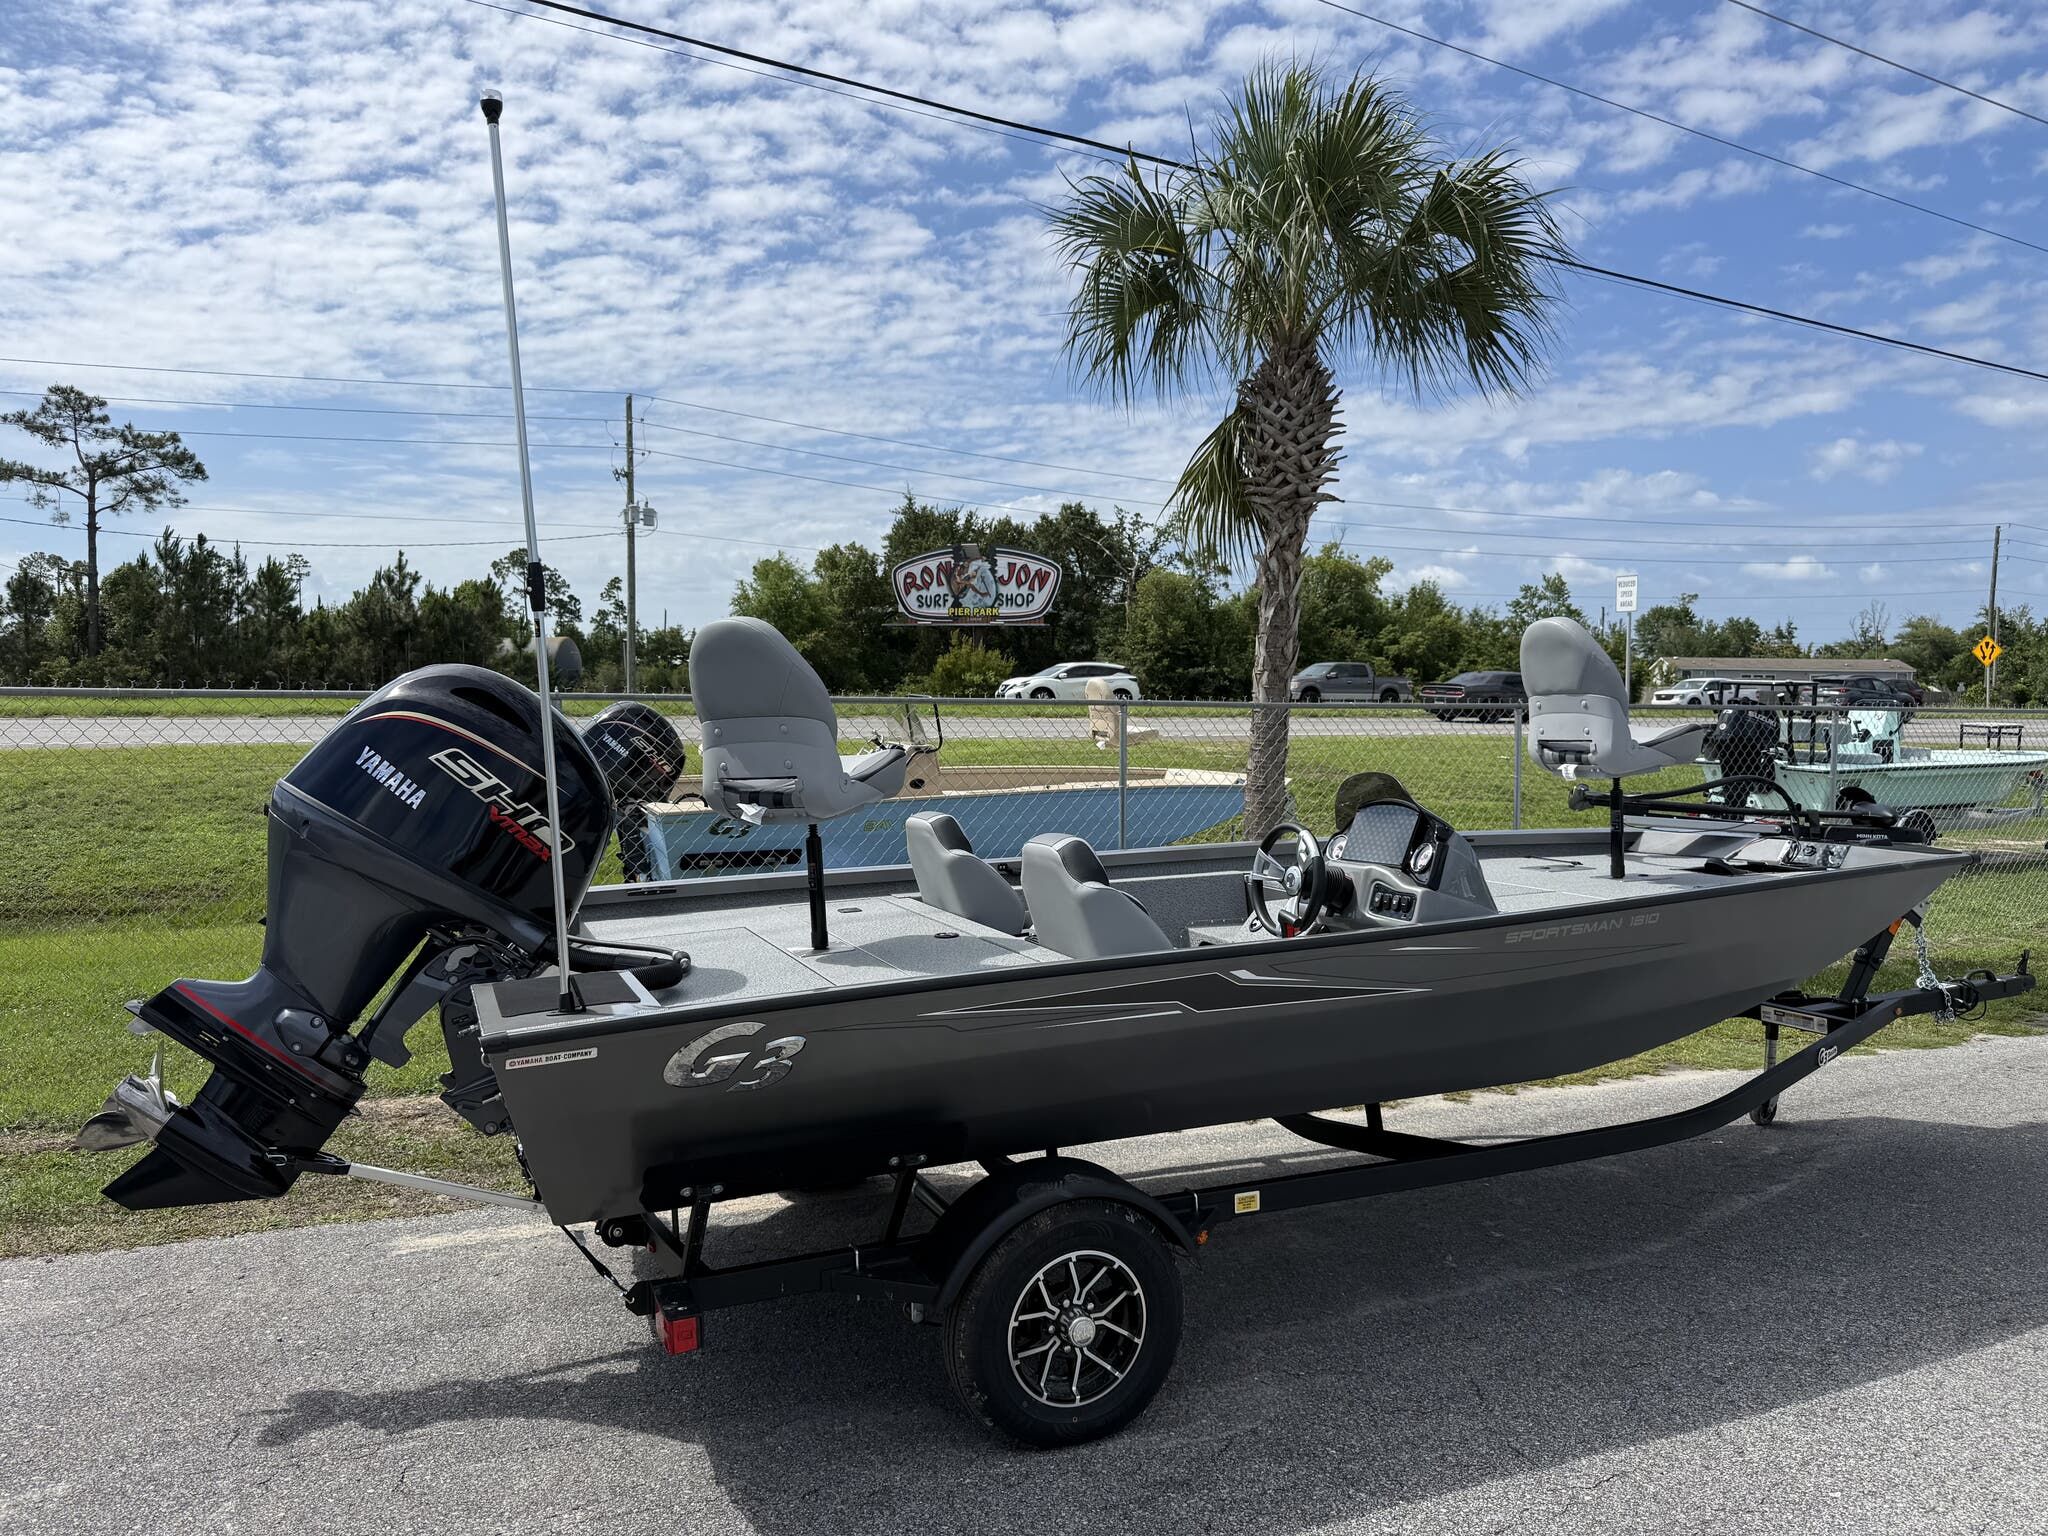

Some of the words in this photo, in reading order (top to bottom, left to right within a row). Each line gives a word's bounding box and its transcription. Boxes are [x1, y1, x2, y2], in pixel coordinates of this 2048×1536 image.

[903, 561, 951, 596] RON
[999, 562, 1051, 593] JON
[1618, 580, 1635, 588] REDUCED
[917, 593, 949, 608] SURF
[998, 593, 1035, 608] SHOP
[1620, 590, 1633, 598] SPEED
[948, 607, 971, 616] PIER
[973, 607, 999, 616] PARK
[602, 733, 629, 757] YAMAHA
[355, 745, 427, 810] YAMAHA
[428, 748, 576, 855] SHO
[1504, 917, 1624, 944] SPORTSMAN
[1630, 913, 1660, 928] 1810
[516, 1057, 543, 1067] YAMAHA
[663, 1021, 807, 1092] G3
